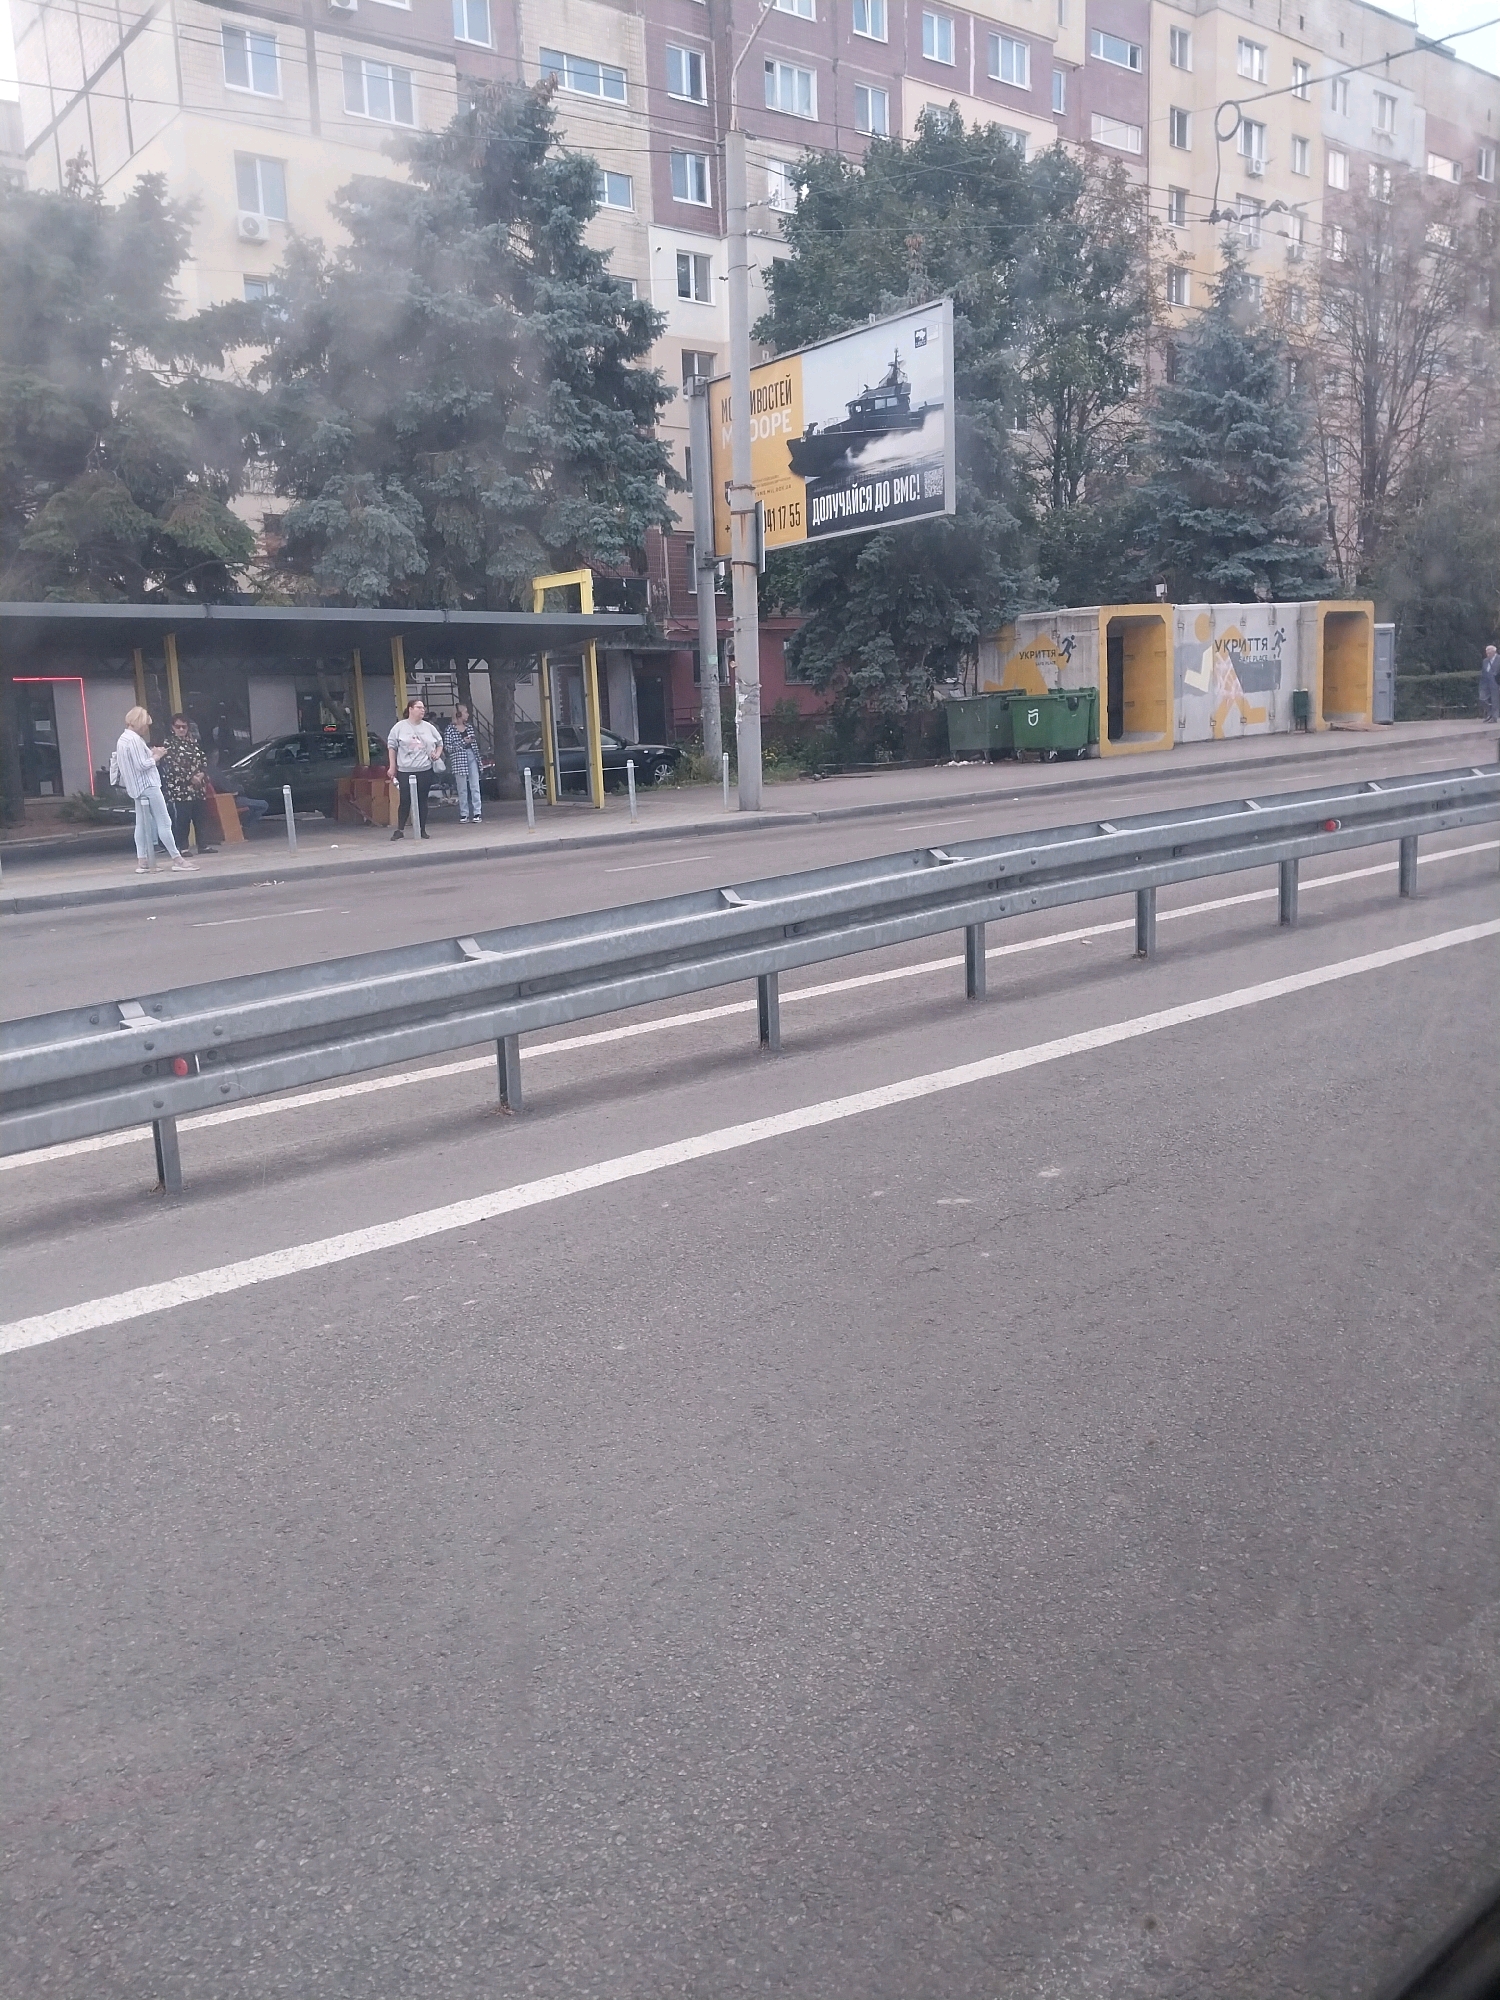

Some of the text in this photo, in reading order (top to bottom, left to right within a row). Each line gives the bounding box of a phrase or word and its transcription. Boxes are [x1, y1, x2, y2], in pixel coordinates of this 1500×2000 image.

[812, 473, 920, 526] ДОЛУЧАЙСЯ ДО ВМС!
[778, 505, 787, 530] 17
[789, 502, 801, 528] 55
[1019, 649, 1056, 660] УКРИТТЯ
[1215, 637, 1268, 653] УКРИТТЯ
